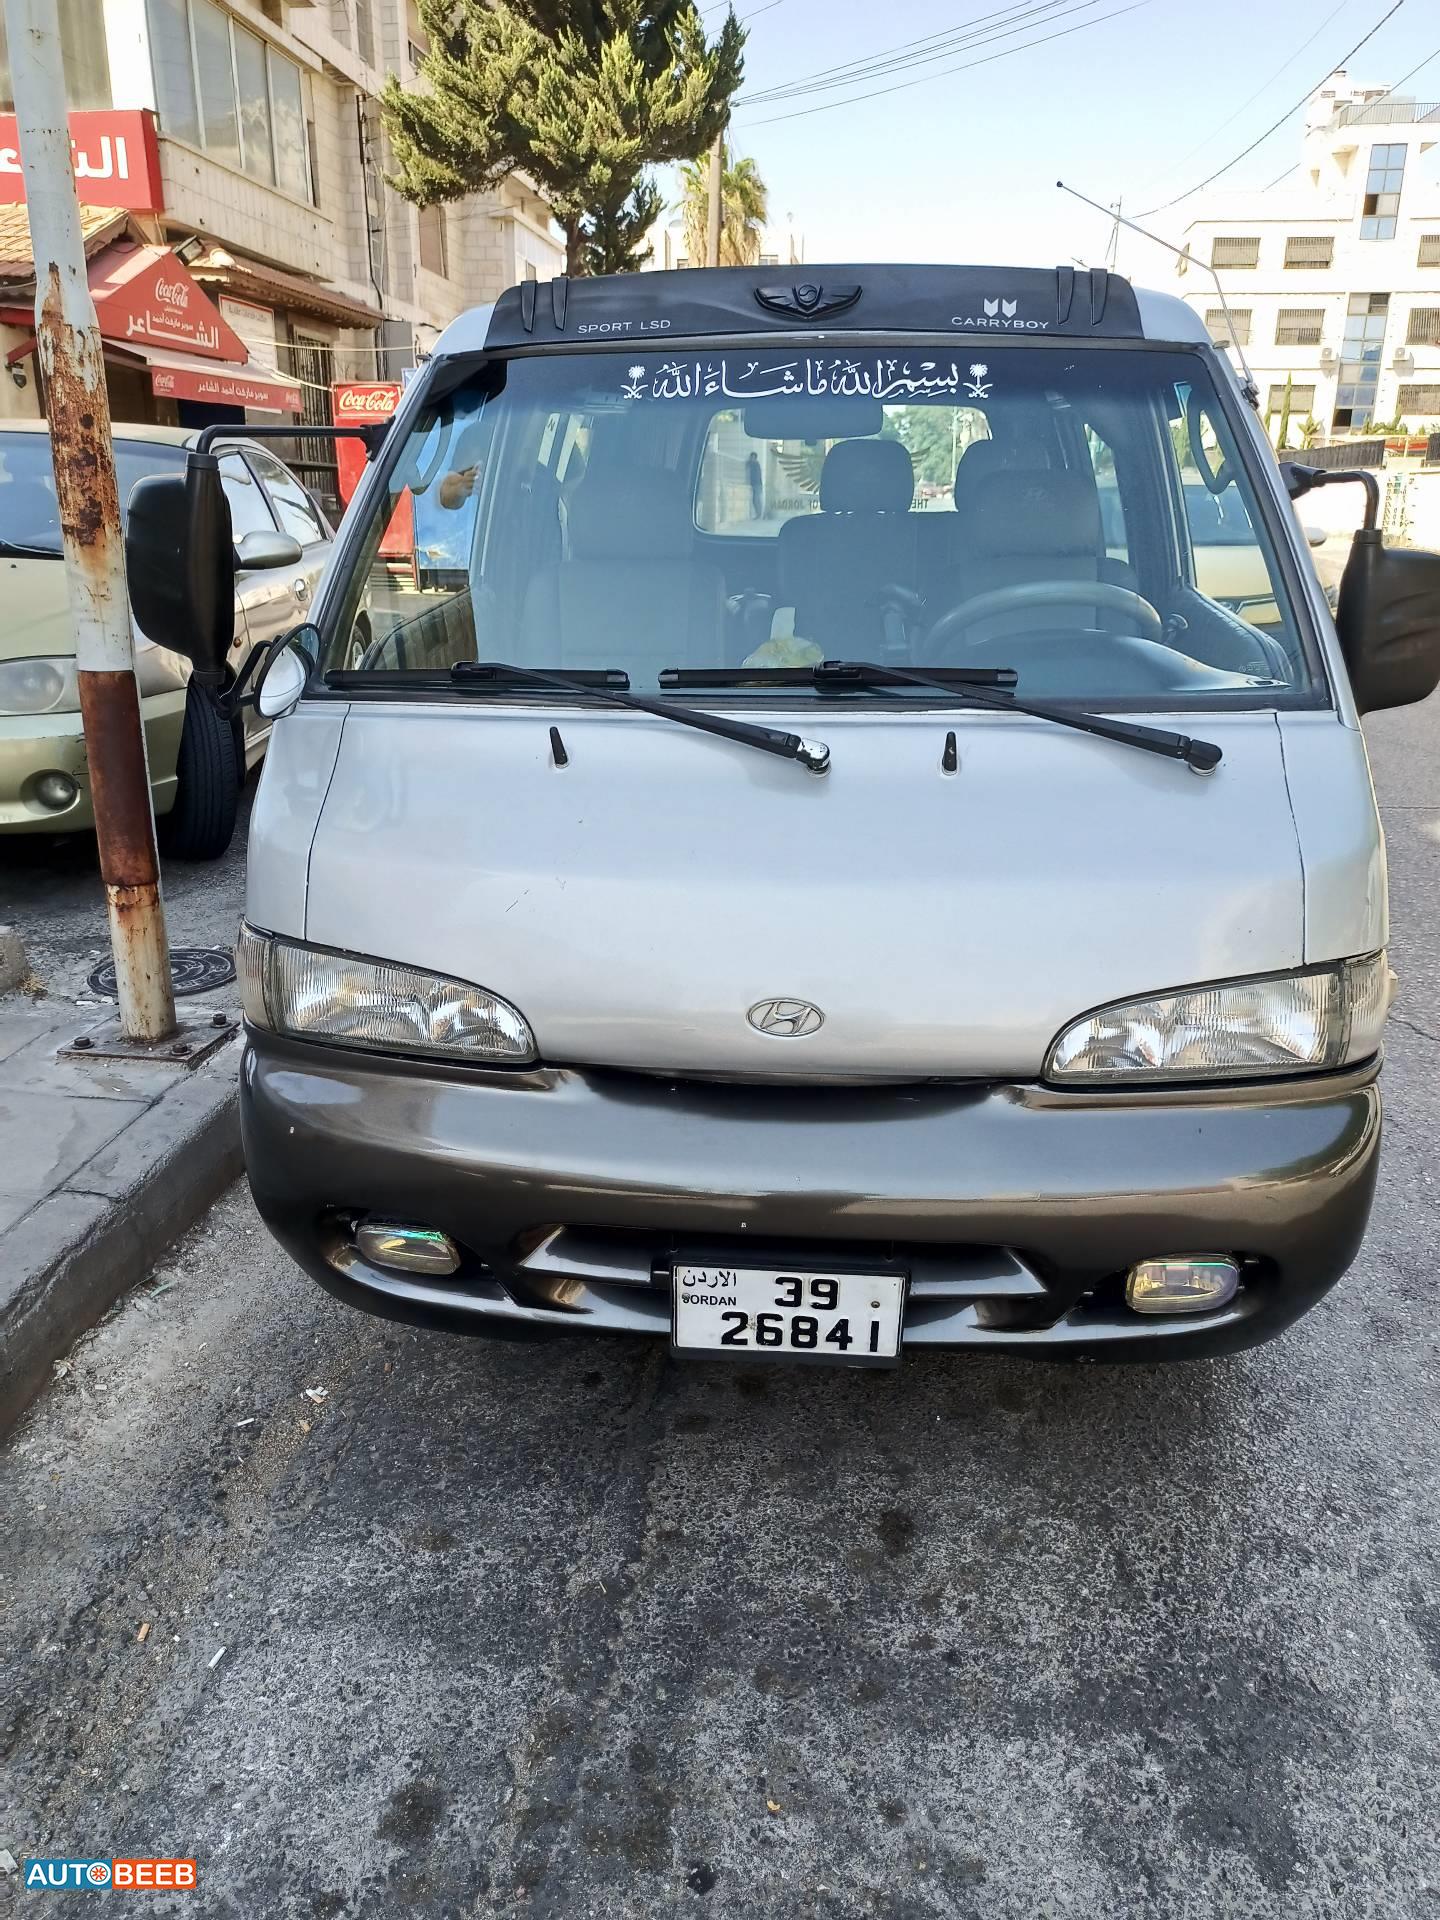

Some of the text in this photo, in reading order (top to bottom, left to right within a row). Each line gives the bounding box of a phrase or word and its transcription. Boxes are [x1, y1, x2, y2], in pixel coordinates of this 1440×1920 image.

[126, 310, 219, 350] الشاعر
[578, 319, 671, 334] SPORT LSD
[951, 316, 1049, 329] CARRYBOY
[339, 390, 397, 411] Coca-Cola
[682, 1269, 737, 1288] الاردن
[774, 1276, 840, 1311] 39
[720, 1311, 881, 1353] 26841
